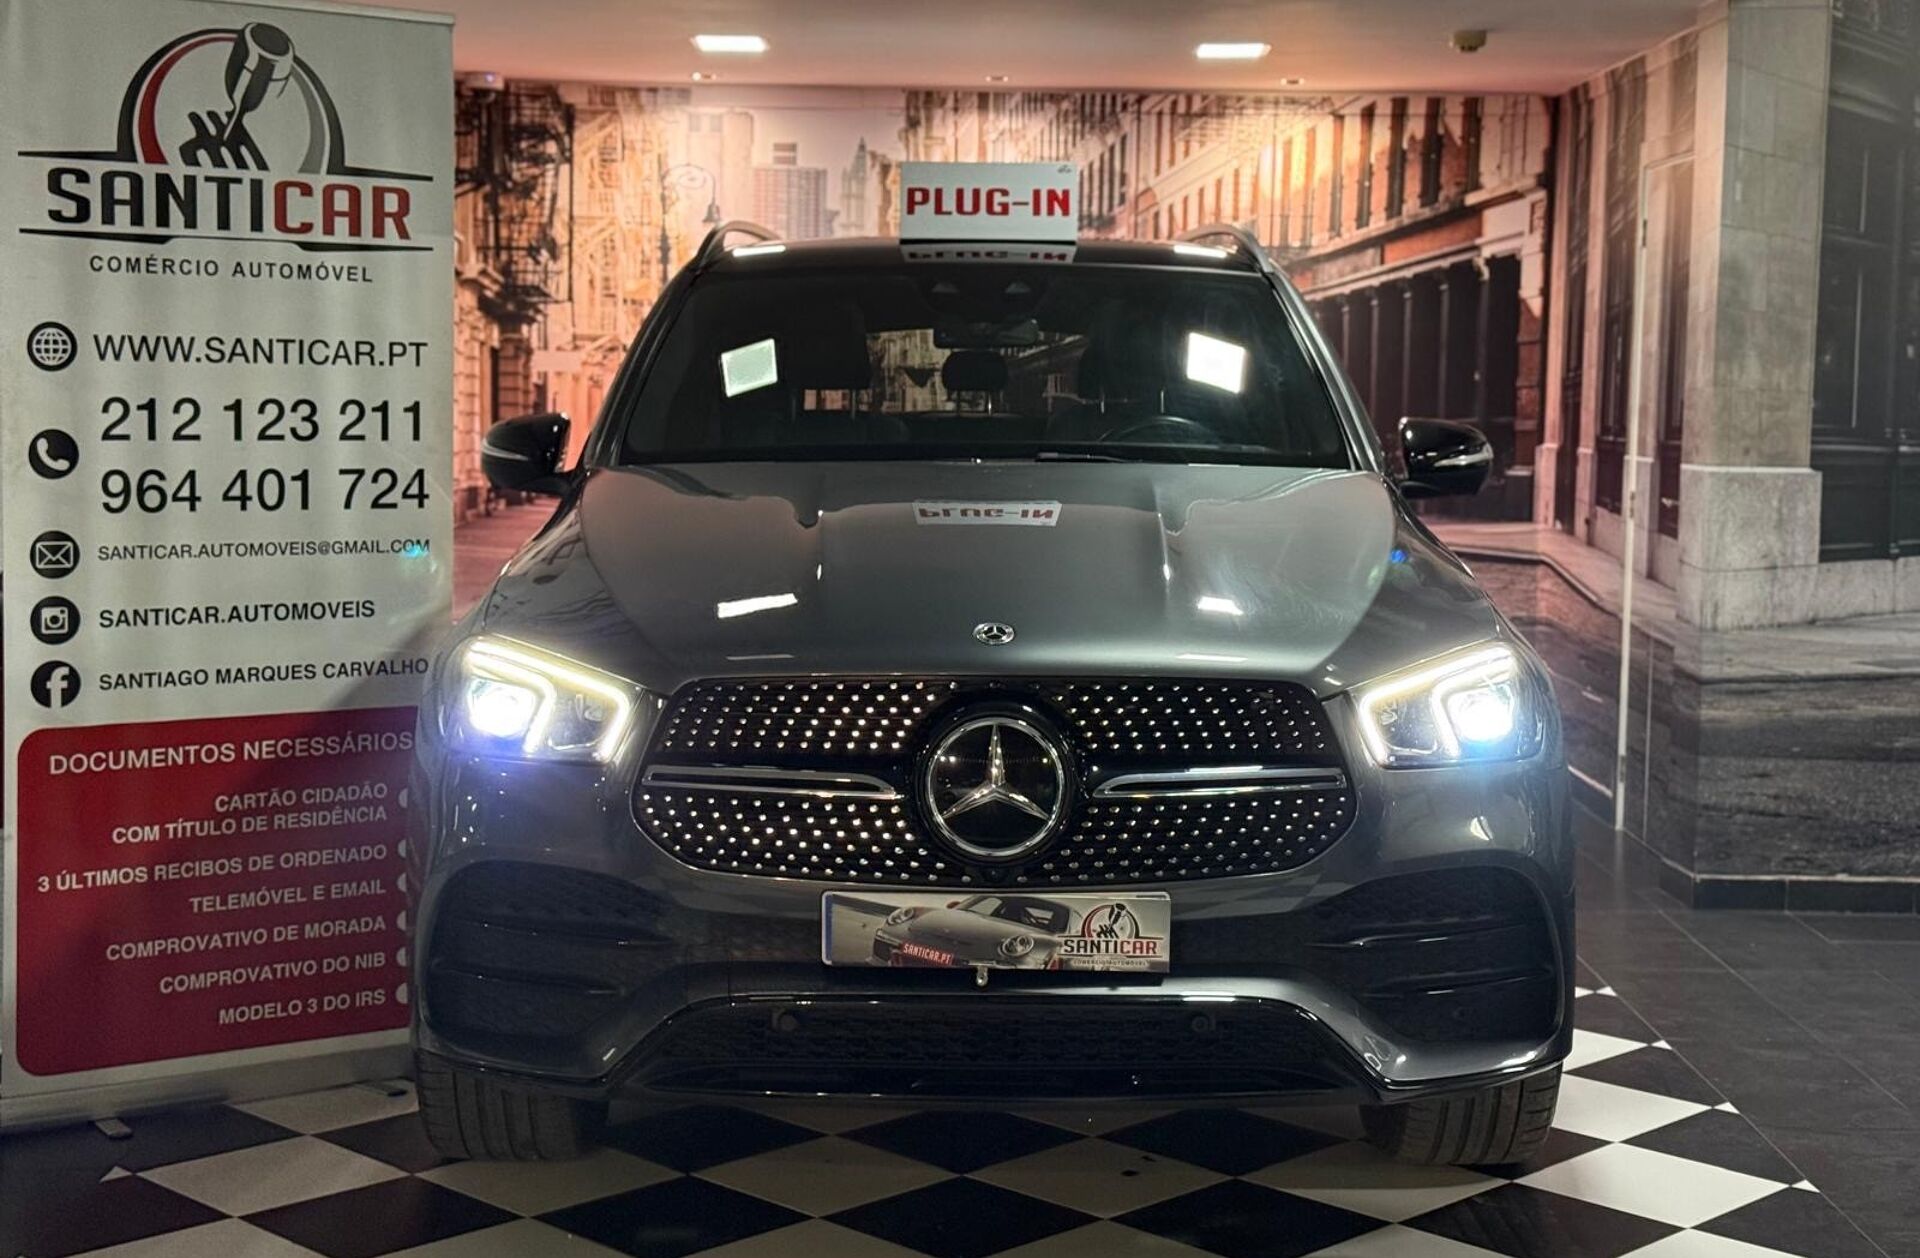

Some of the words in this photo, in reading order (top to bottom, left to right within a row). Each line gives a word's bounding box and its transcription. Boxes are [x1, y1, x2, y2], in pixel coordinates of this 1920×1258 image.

[47, 167, 412, 241] SANTICAR
[906, 187, 1070, 217] PLUG-IN
[89, 253, 220, 277] COMÉRCIO
[231, 259, 374, 283] AUTOMÓVEL
[93, 334, 429, 367] WWW.SANTICAR.PT
[100, 396, 202, 442] 212
[222, 398, 320, 442] 123
[338, 399, 422, 442] 211
[100, 468, 202, 514] 964
[222, 468, 311, 512] 401
[338, 467, 430, 511] 724
[97, 538, 431, 561] SANTICAR.AUTOMOVEIS@GMAIL.COM
[98, 599, 376, 629] SANTICAR.AUTOMOVEIS
[98, 668, 209, 691] SANTIAGO
[214, 663, 318, 686] MARQUES
[322, 657, 429, 680] CARVALHO
[49, 742, 236, 775] DOCUMENTOS
[243, 730, 414, 762] NECESSÁRIOS
[214, 788, 297, 813] CARTÃO
[302, 782, 388, 805] CIDADÃO
[112, 825, 160, 845] COM
[165, 815, 237, 840] TÍTULO
[241, 816, 269, 834] DE
[273, 804, 388, 831] RESIDÊNCIA
[37, 876, 50, 893] 3
[56, 866, 149, 891] ÚLTIMOS
[154, 858, 243, 881] RECIBOS
[248, 854, 275, 872] DE
[280, 844, 388, 868] ORDENADO
[190, 885, 307, 914] TELEMÓVEL
[312, 884, 326, 901] E
[330, 877, 387, 899] EMAIL
[106, 929, 268, 962] COMPROVATIVO
[272, 925, 299, 943] DE
[303, 916, 387, 940] MORADA
[1063, 939, 1158, 955] SANTICAR
[159, 961, 318, 995] COMPROVATIVO
[322, 956, 350, 974] DO
[354, 951, 386, 970] NIB
[218, 1000, 302, 1025] MODELO
[306, 998, 318, 1015] 3
[323, 993, 350, 1011] DO
[355, 988, 386, 1008] IRS
